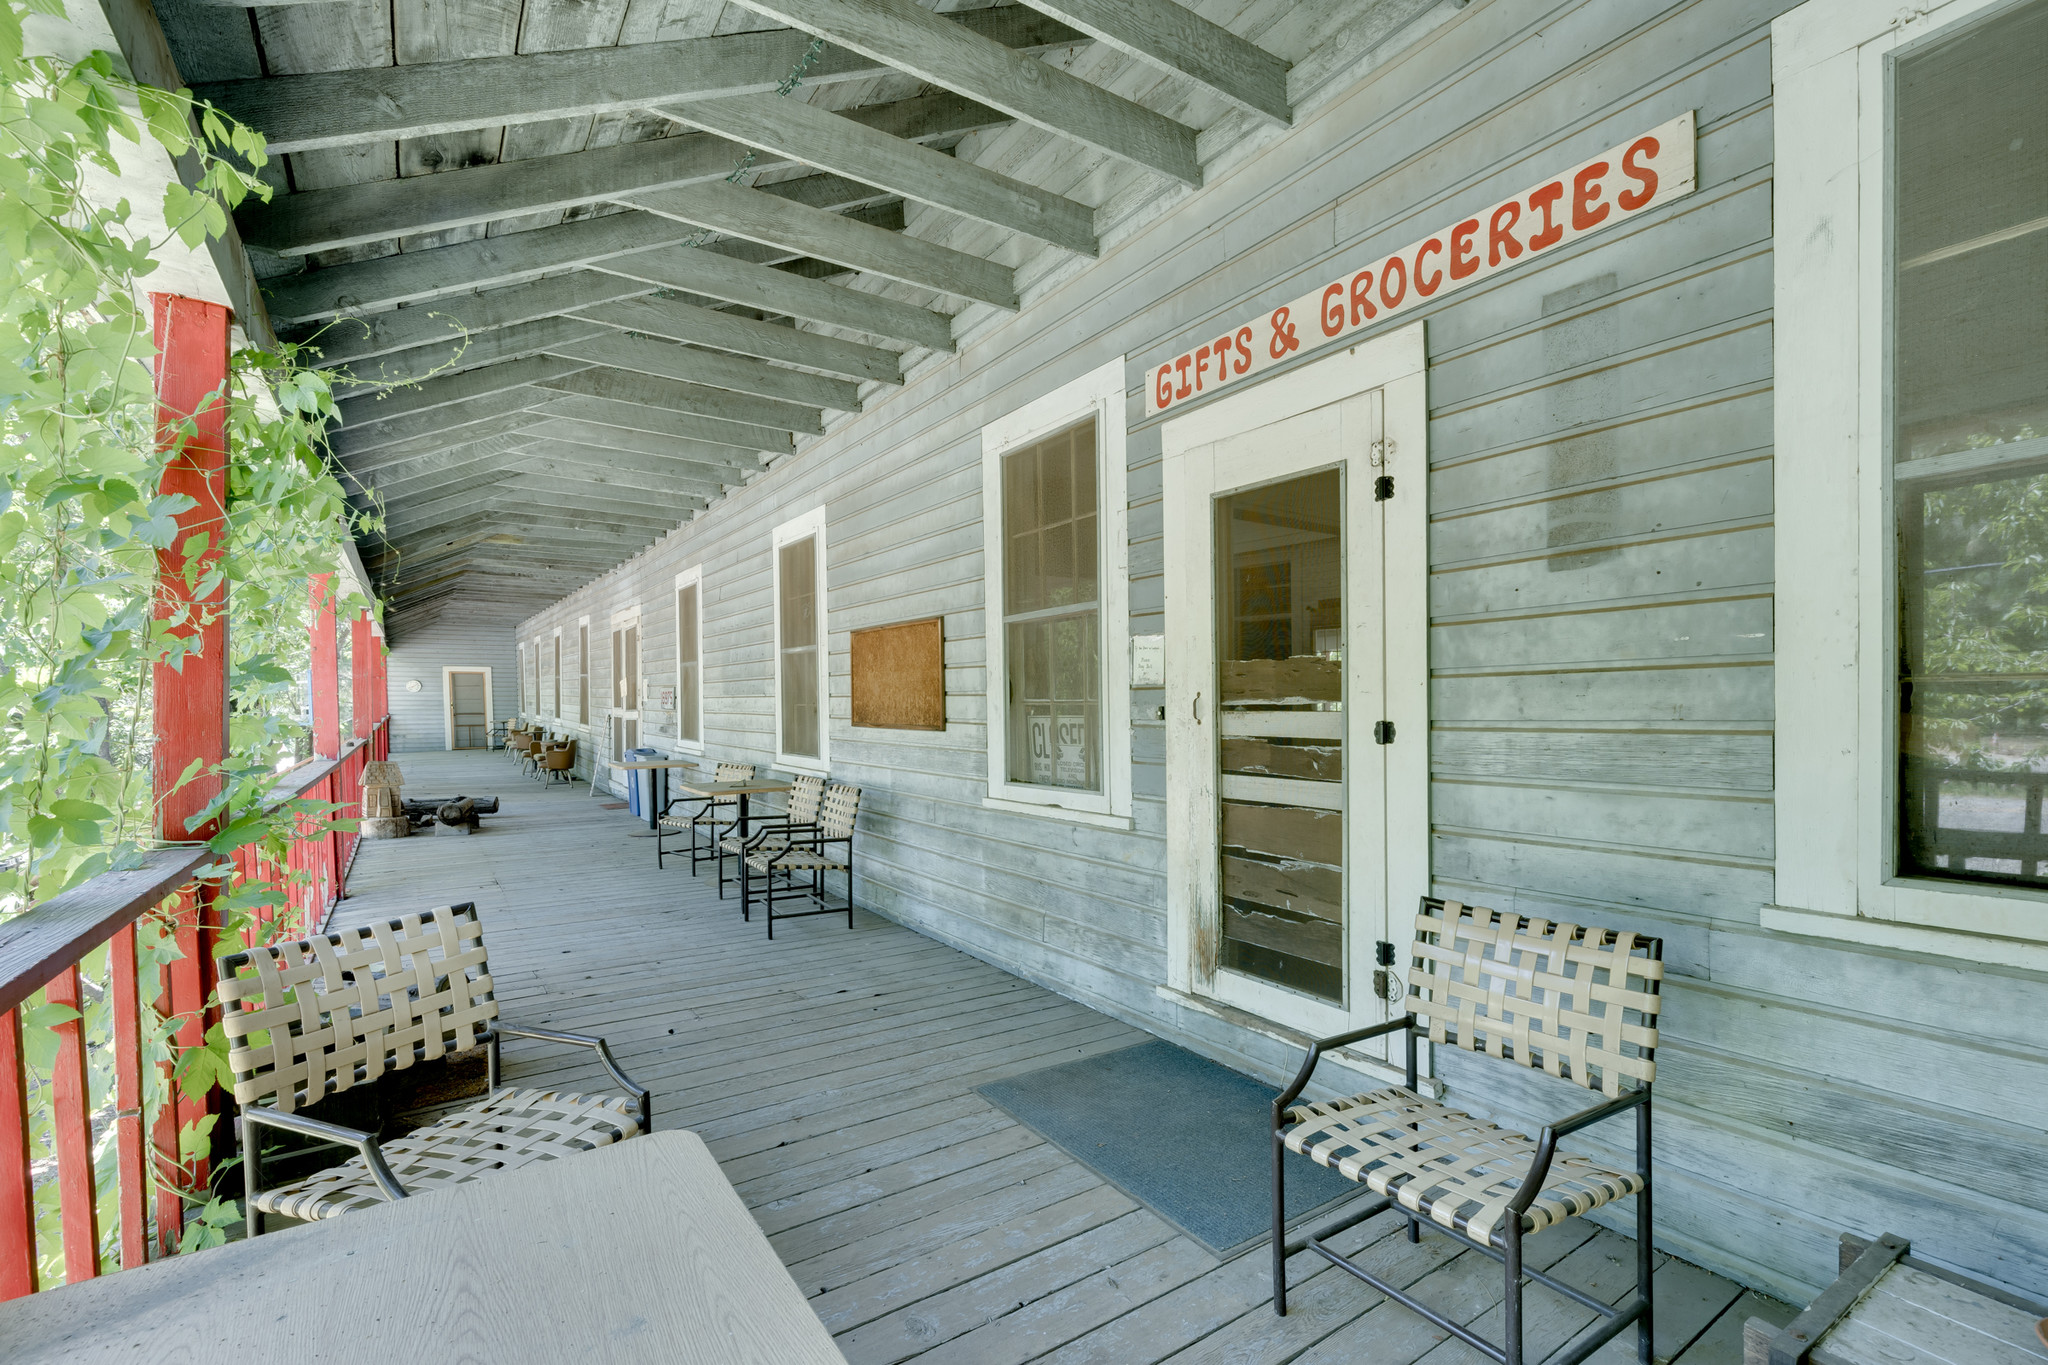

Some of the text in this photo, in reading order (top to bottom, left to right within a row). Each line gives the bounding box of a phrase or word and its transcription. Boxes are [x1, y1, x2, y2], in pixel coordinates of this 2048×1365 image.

[1156, 136, 1660, 408] GIFTS & GROCERIES
